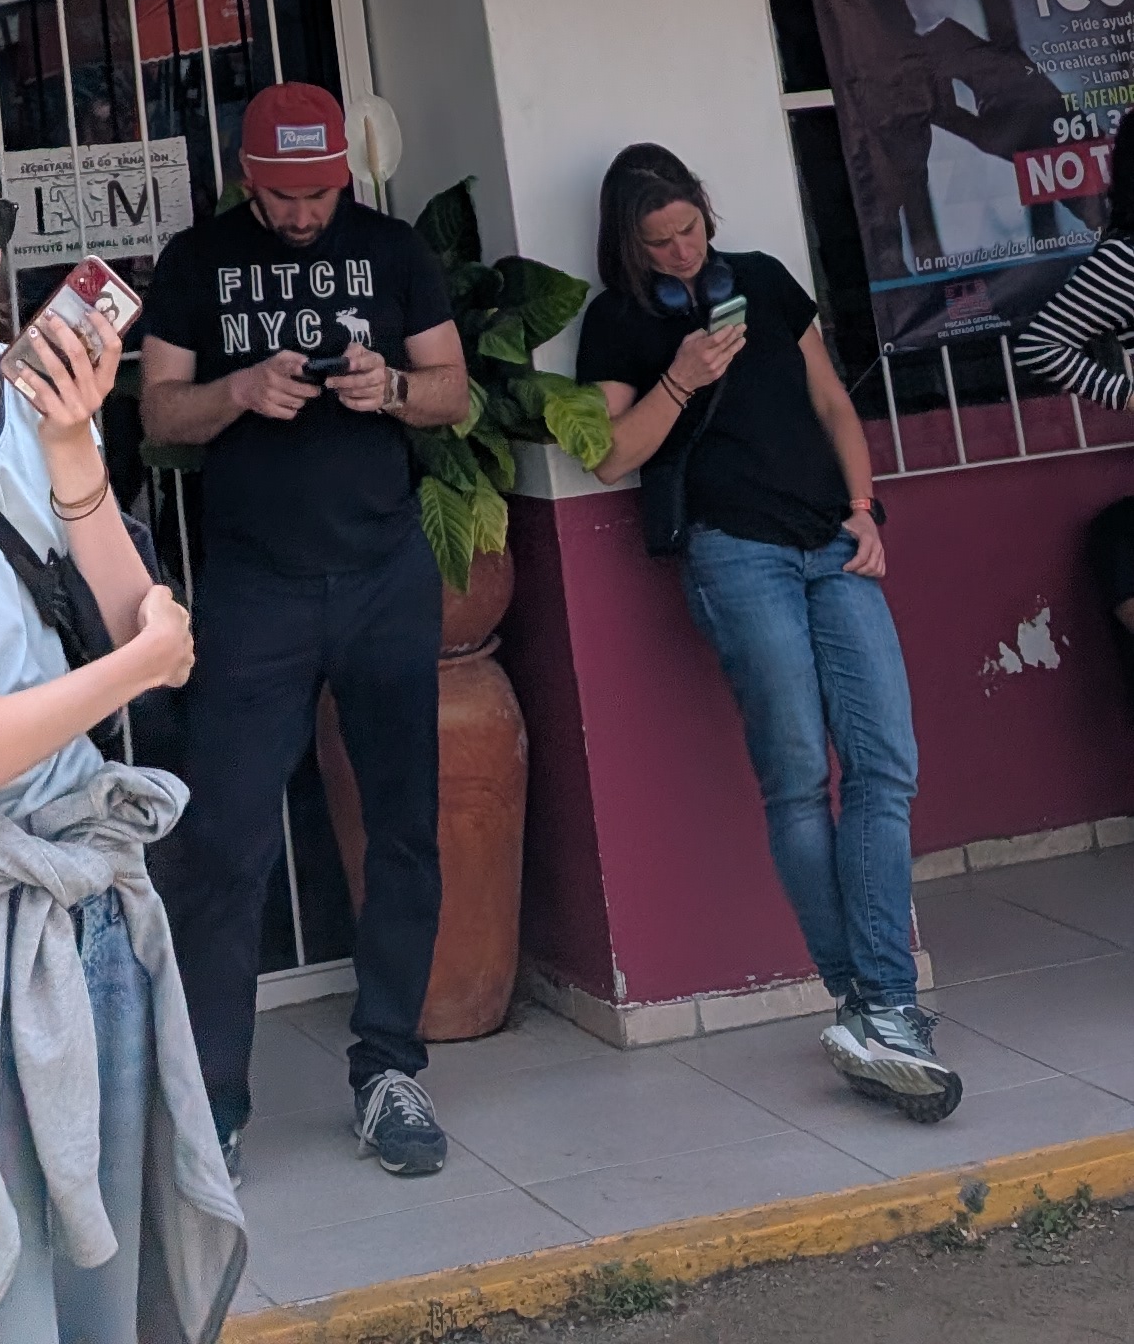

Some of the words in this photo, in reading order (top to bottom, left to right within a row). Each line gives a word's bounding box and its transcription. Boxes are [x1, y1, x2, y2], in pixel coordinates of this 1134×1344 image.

[1071, 17, 1100, 32] Pide
[1102, 11, 1134, 31] ayud
[1041, 36, 1099, 55] Contacta
[1101, 36, 1109, 46] a
[1036, 59, 1057, 74] NO
[1059, 54, 1108, 71] realices
[1092, 69, 1130, 84] Llama
[1061, 93, 1080, 112] TE
[1053, 112, 1100, 143] 961
[1026, 151, 1085, 196] NO
[916, 256, 932, 272] La
[217, 259, 374, 304] FITCH
[220, 308, 323, 354] NYC
